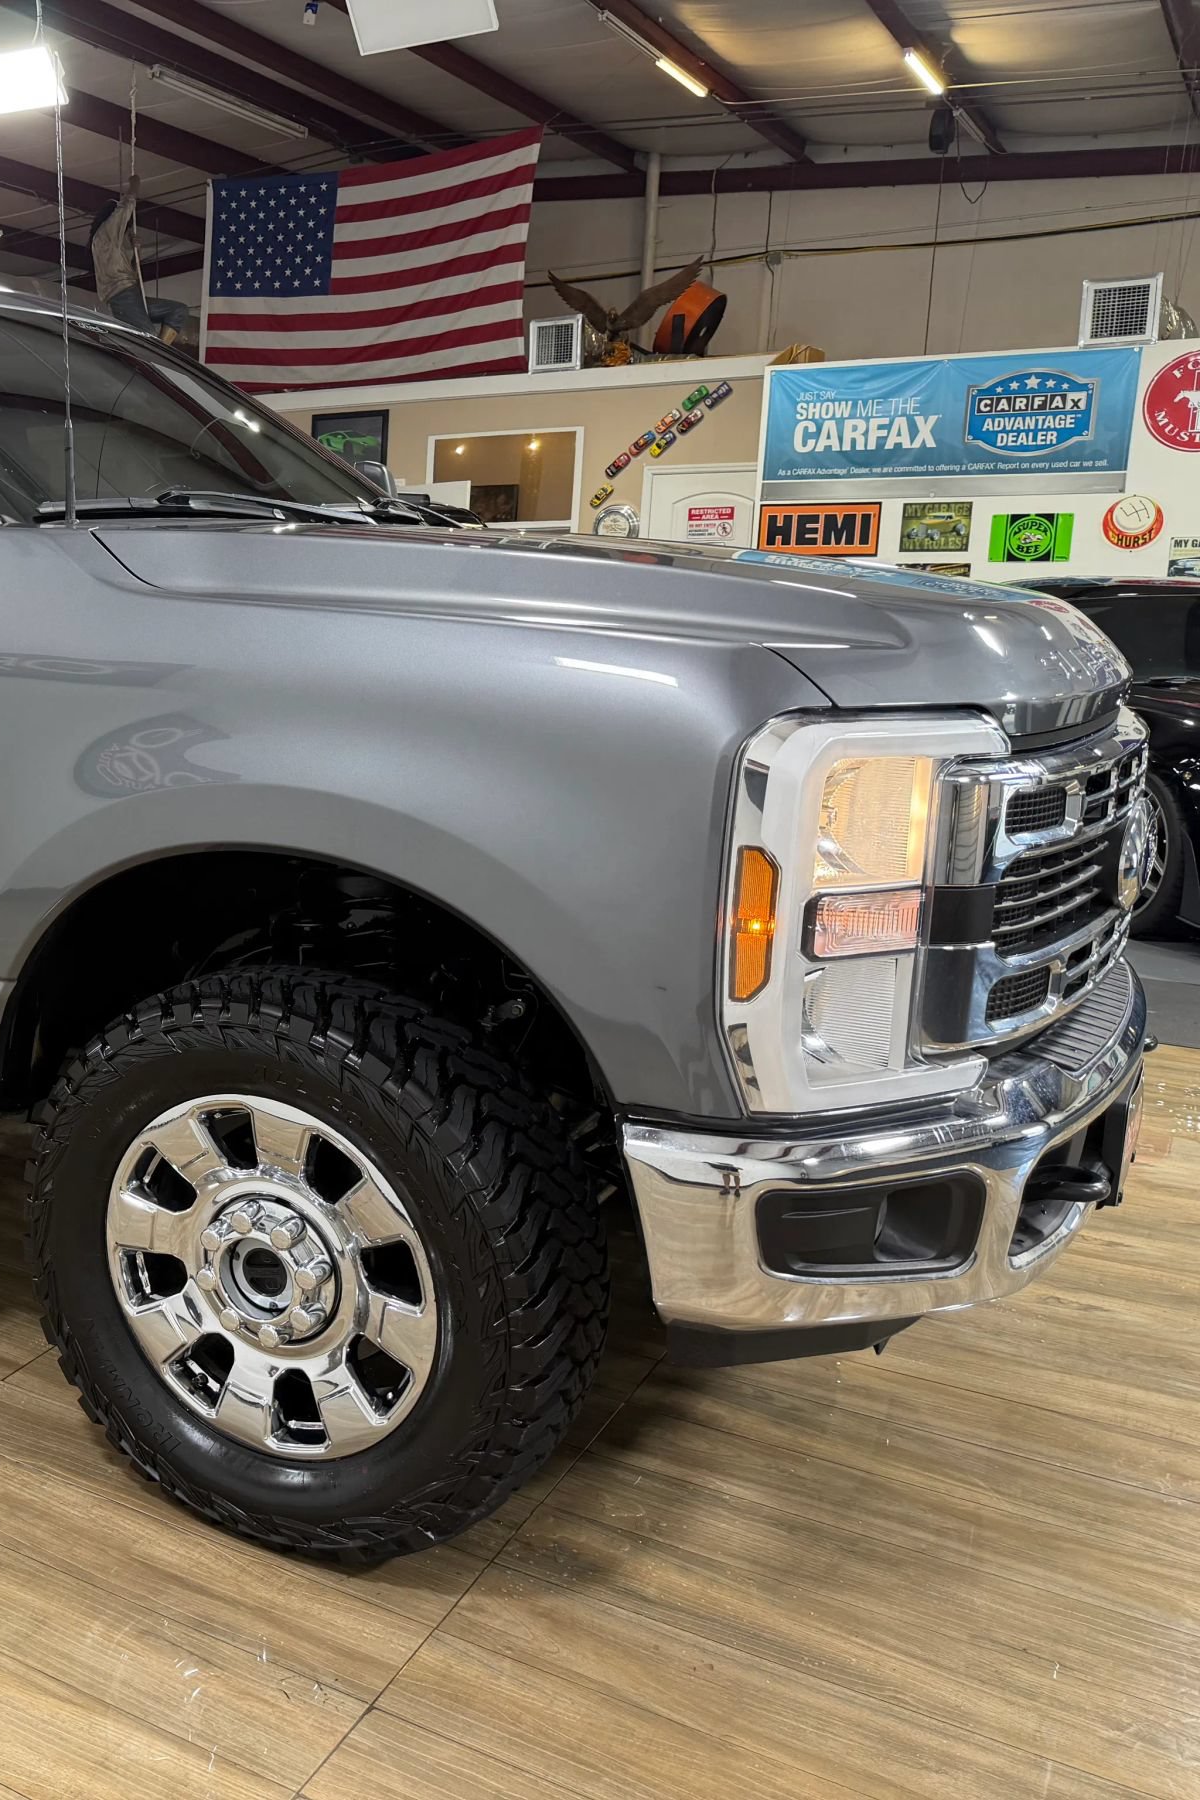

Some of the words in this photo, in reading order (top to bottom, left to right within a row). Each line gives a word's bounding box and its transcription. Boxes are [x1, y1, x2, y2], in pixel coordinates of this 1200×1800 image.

[796, 391, 818, 402] JUST
[820, 390, 836, 400] SAY
[979, 395, 1083, 413] CARFAX
[796, 400, 852, 420] SHOW
[856, 400, 882, 417] ME
[889, 397, 921, 415] THE
[982, 414, 1075, 431] ADVANTAGE
[793, 415, 939, 453] CARFAX
[996, 431, 1058, 447] DEALER
[777, 468, 786, 476] As
[935, 464, 960, 472] offering
[997, 462, 1019, 470] Report
[1051, 460, 1068, 468] used
[691, 507, 731, 515] RESTRICTED
[905, 503, 923, 517] MY
[925, 503, 970, 516] GARAGE
[766, 512, 873, 546] HEMI
[1013, 520, 1048, 537] SUPER
[902, 537, 922, 550] MY
[925, 536, 968, 550] RULES!
[1116, 528, 1154, 548] HURST
[1173, 539, 1189, 548] MY
[1016, 544, 1041, 554] BEE
